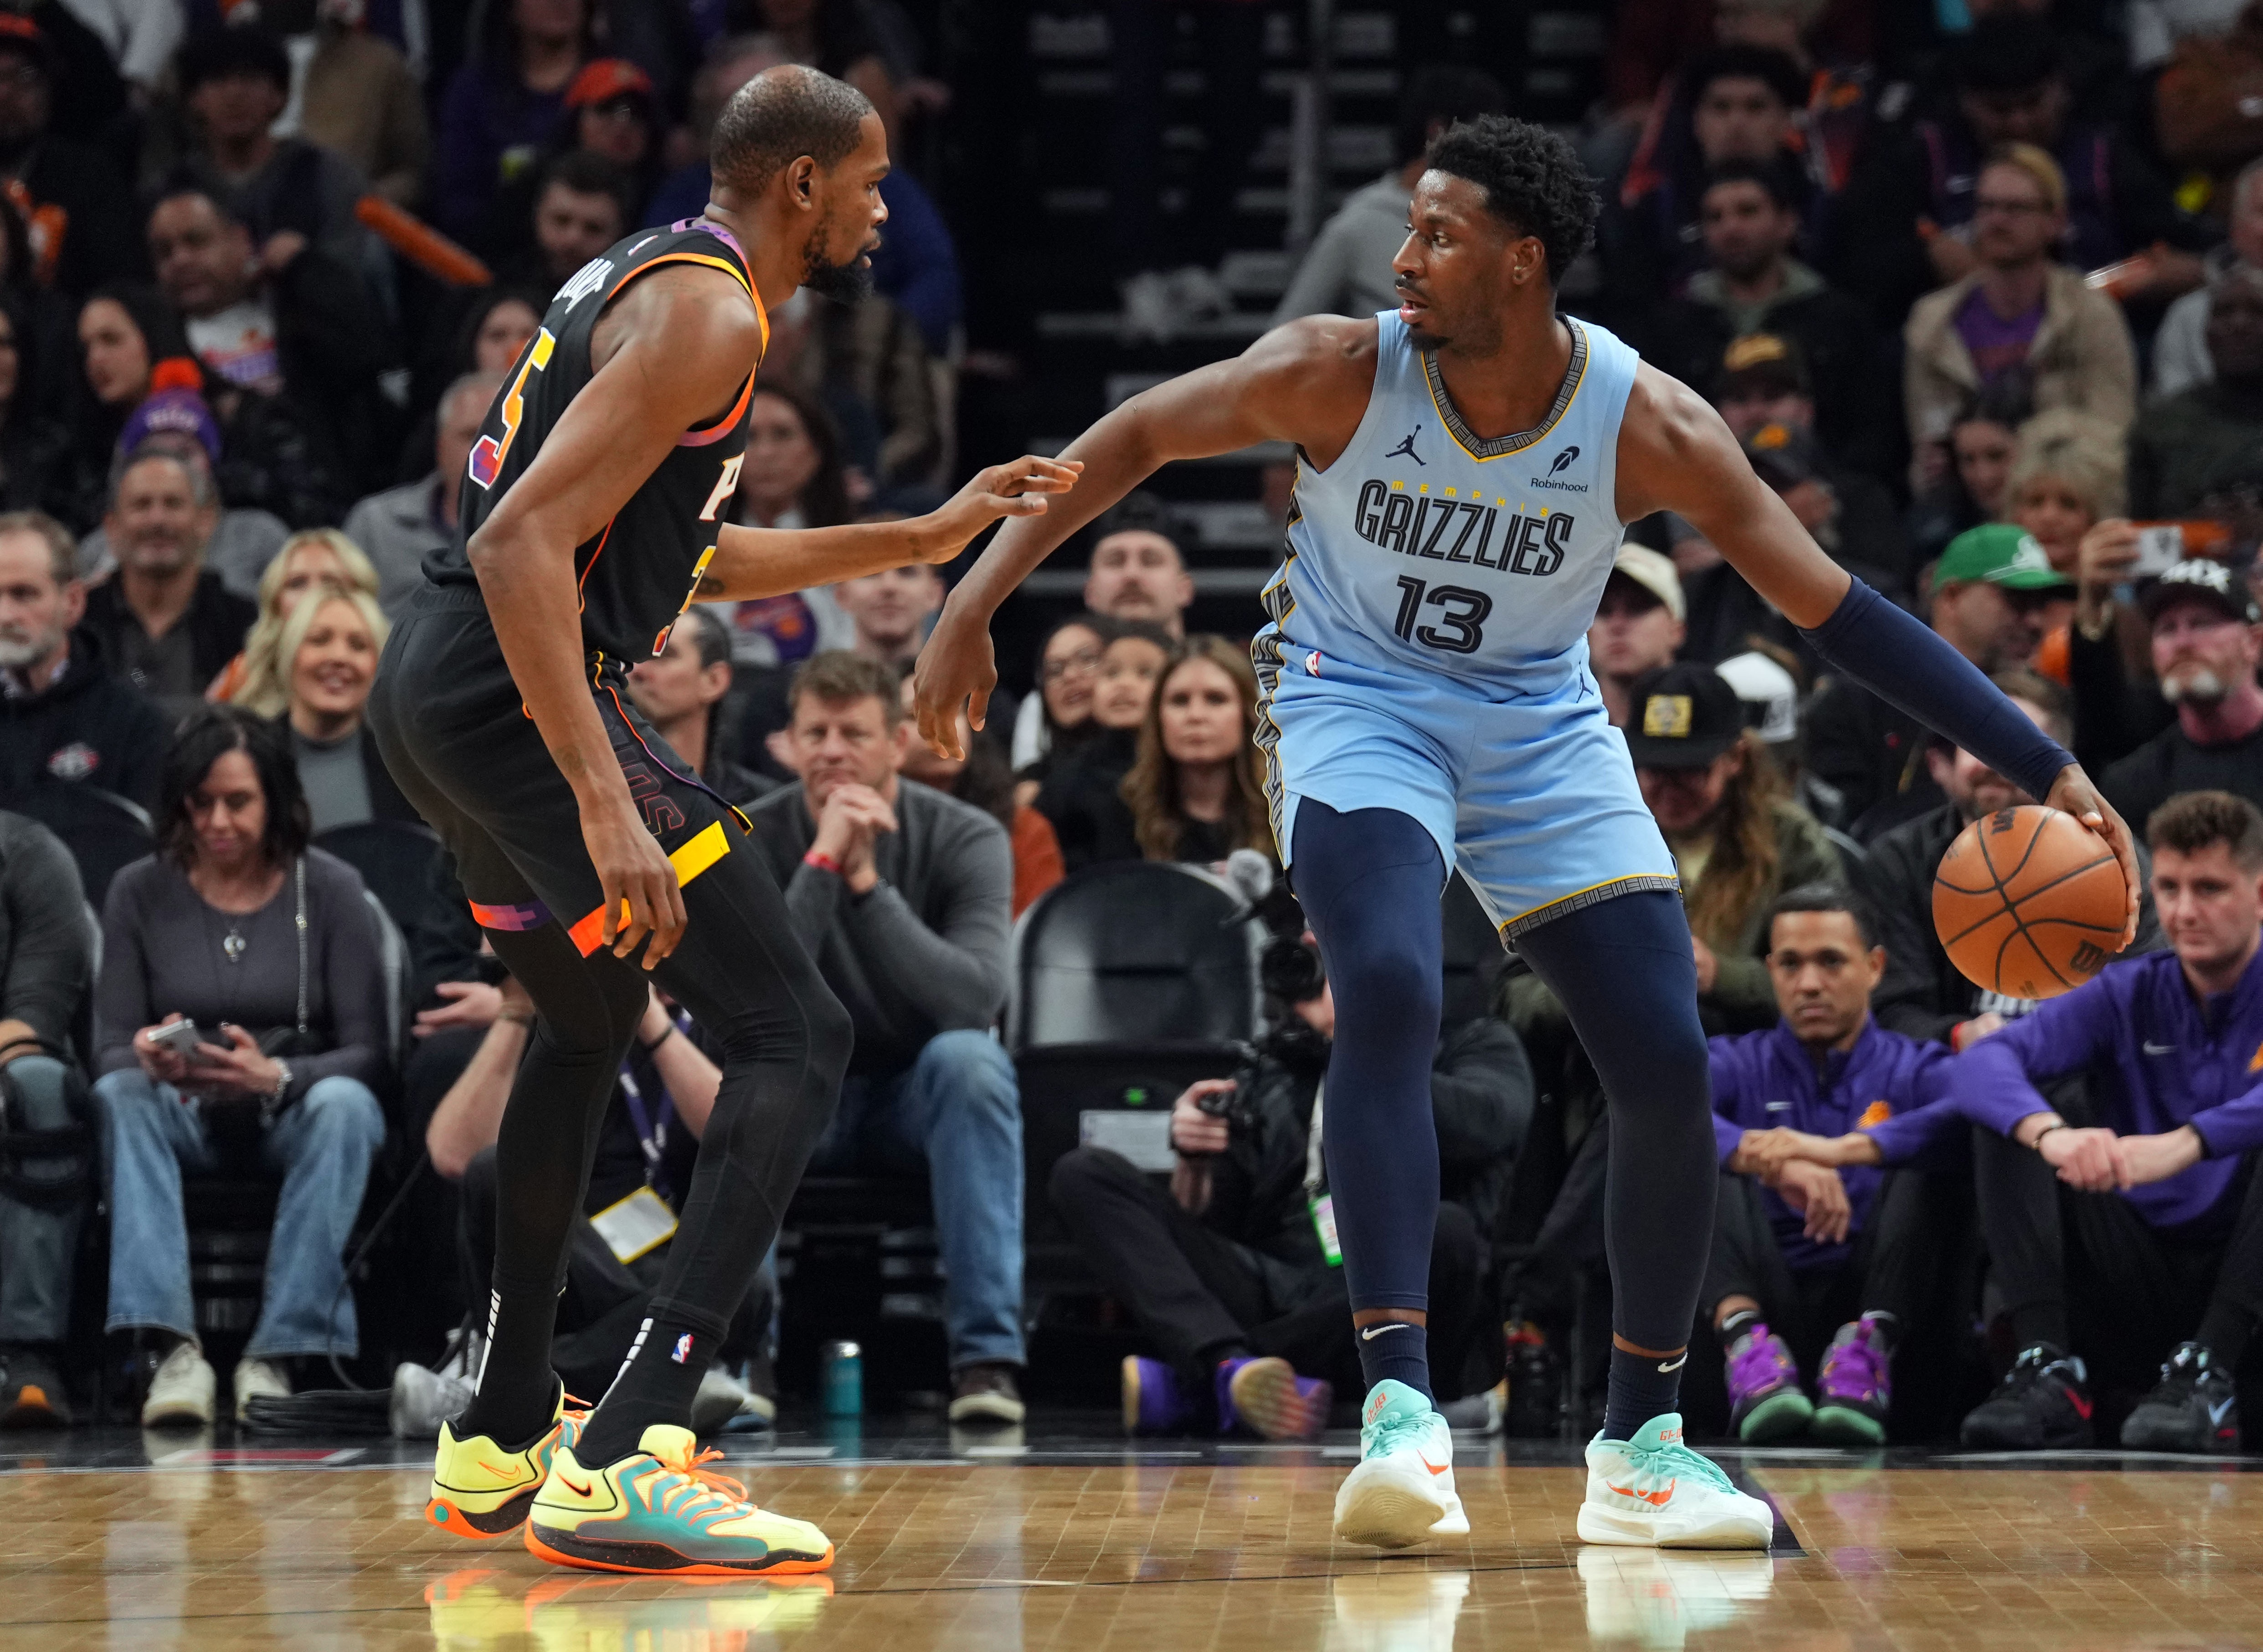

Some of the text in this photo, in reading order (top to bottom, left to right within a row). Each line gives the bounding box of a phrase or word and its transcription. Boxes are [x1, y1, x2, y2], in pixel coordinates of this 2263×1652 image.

[1391, 480, 1549, 517] MEMPHIS
[1531, 478, 1588, 492] Robinhood
[1354, 479, 1575, 576] GRIZZLIES
[1394, 574, 1493, 654] 13
